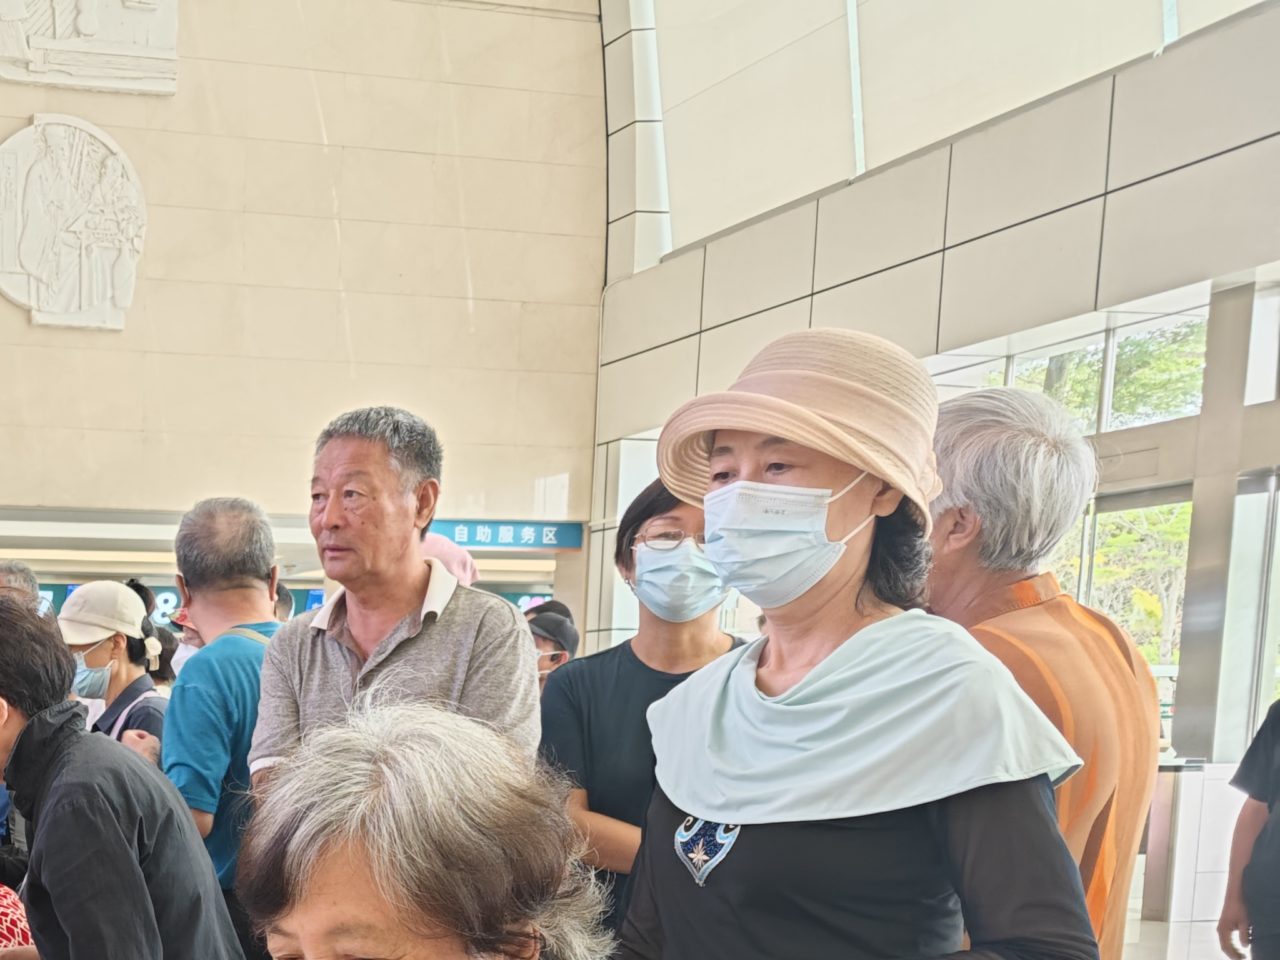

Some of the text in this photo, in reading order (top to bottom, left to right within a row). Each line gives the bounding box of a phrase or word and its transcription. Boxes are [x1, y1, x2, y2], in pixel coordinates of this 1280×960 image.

[454, 524, 558, 545] 自助服务区
[152, 591, 179, 625] 8
